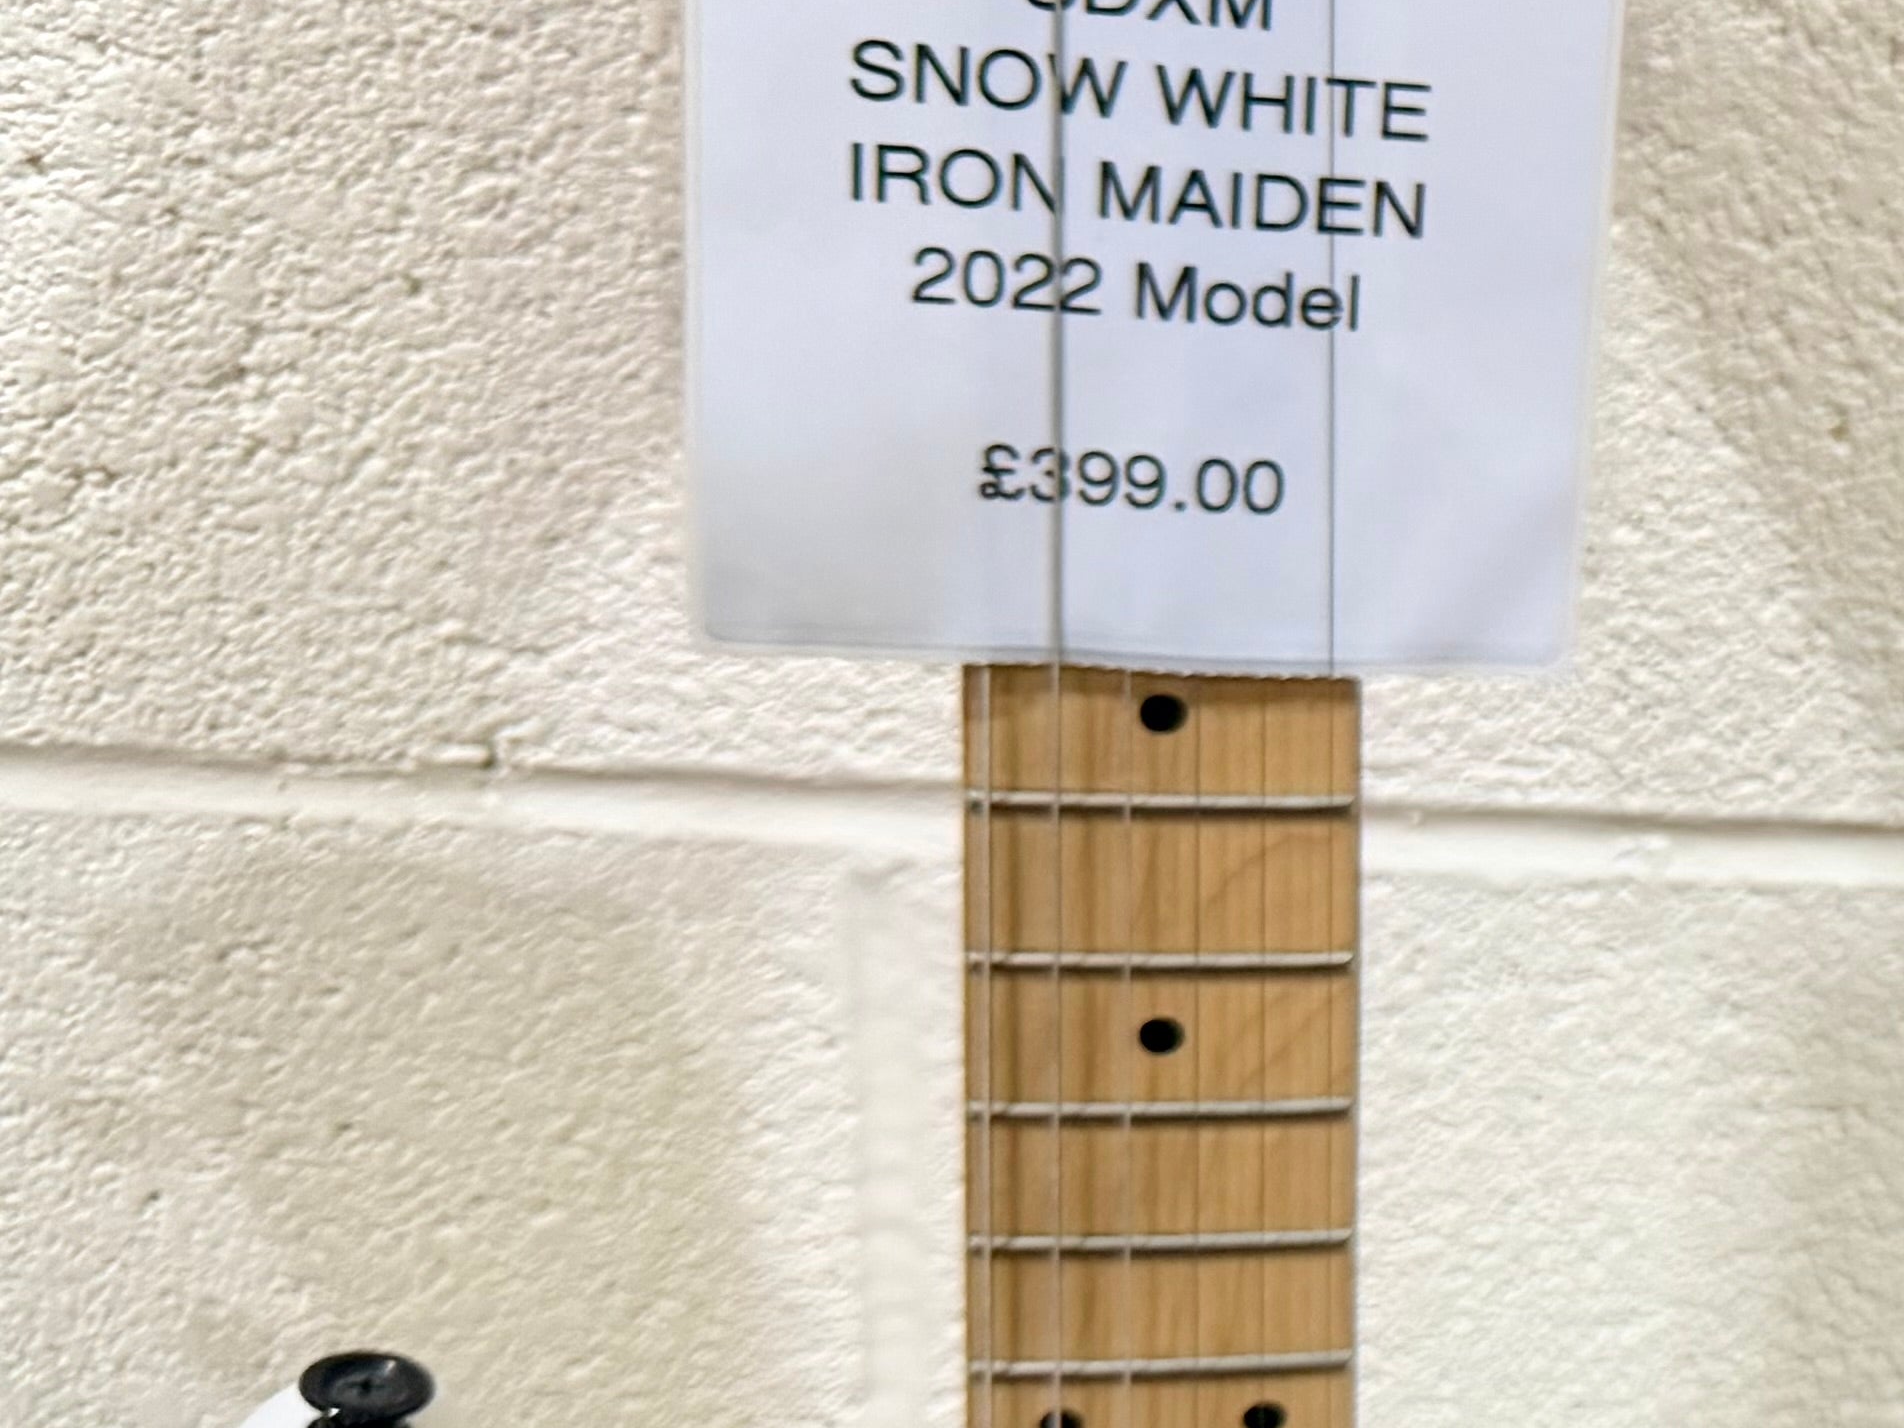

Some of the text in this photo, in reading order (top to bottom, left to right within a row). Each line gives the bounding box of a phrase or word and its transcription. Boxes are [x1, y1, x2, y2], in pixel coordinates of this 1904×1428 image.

[848, 39, 1432, 141] SNOW WHITE
[849, 142, 1427, 239] IRON MAIDEN
[911, 247, 1361, 332] 2022 Model
[977, 444, 1285, 514] £399.00
